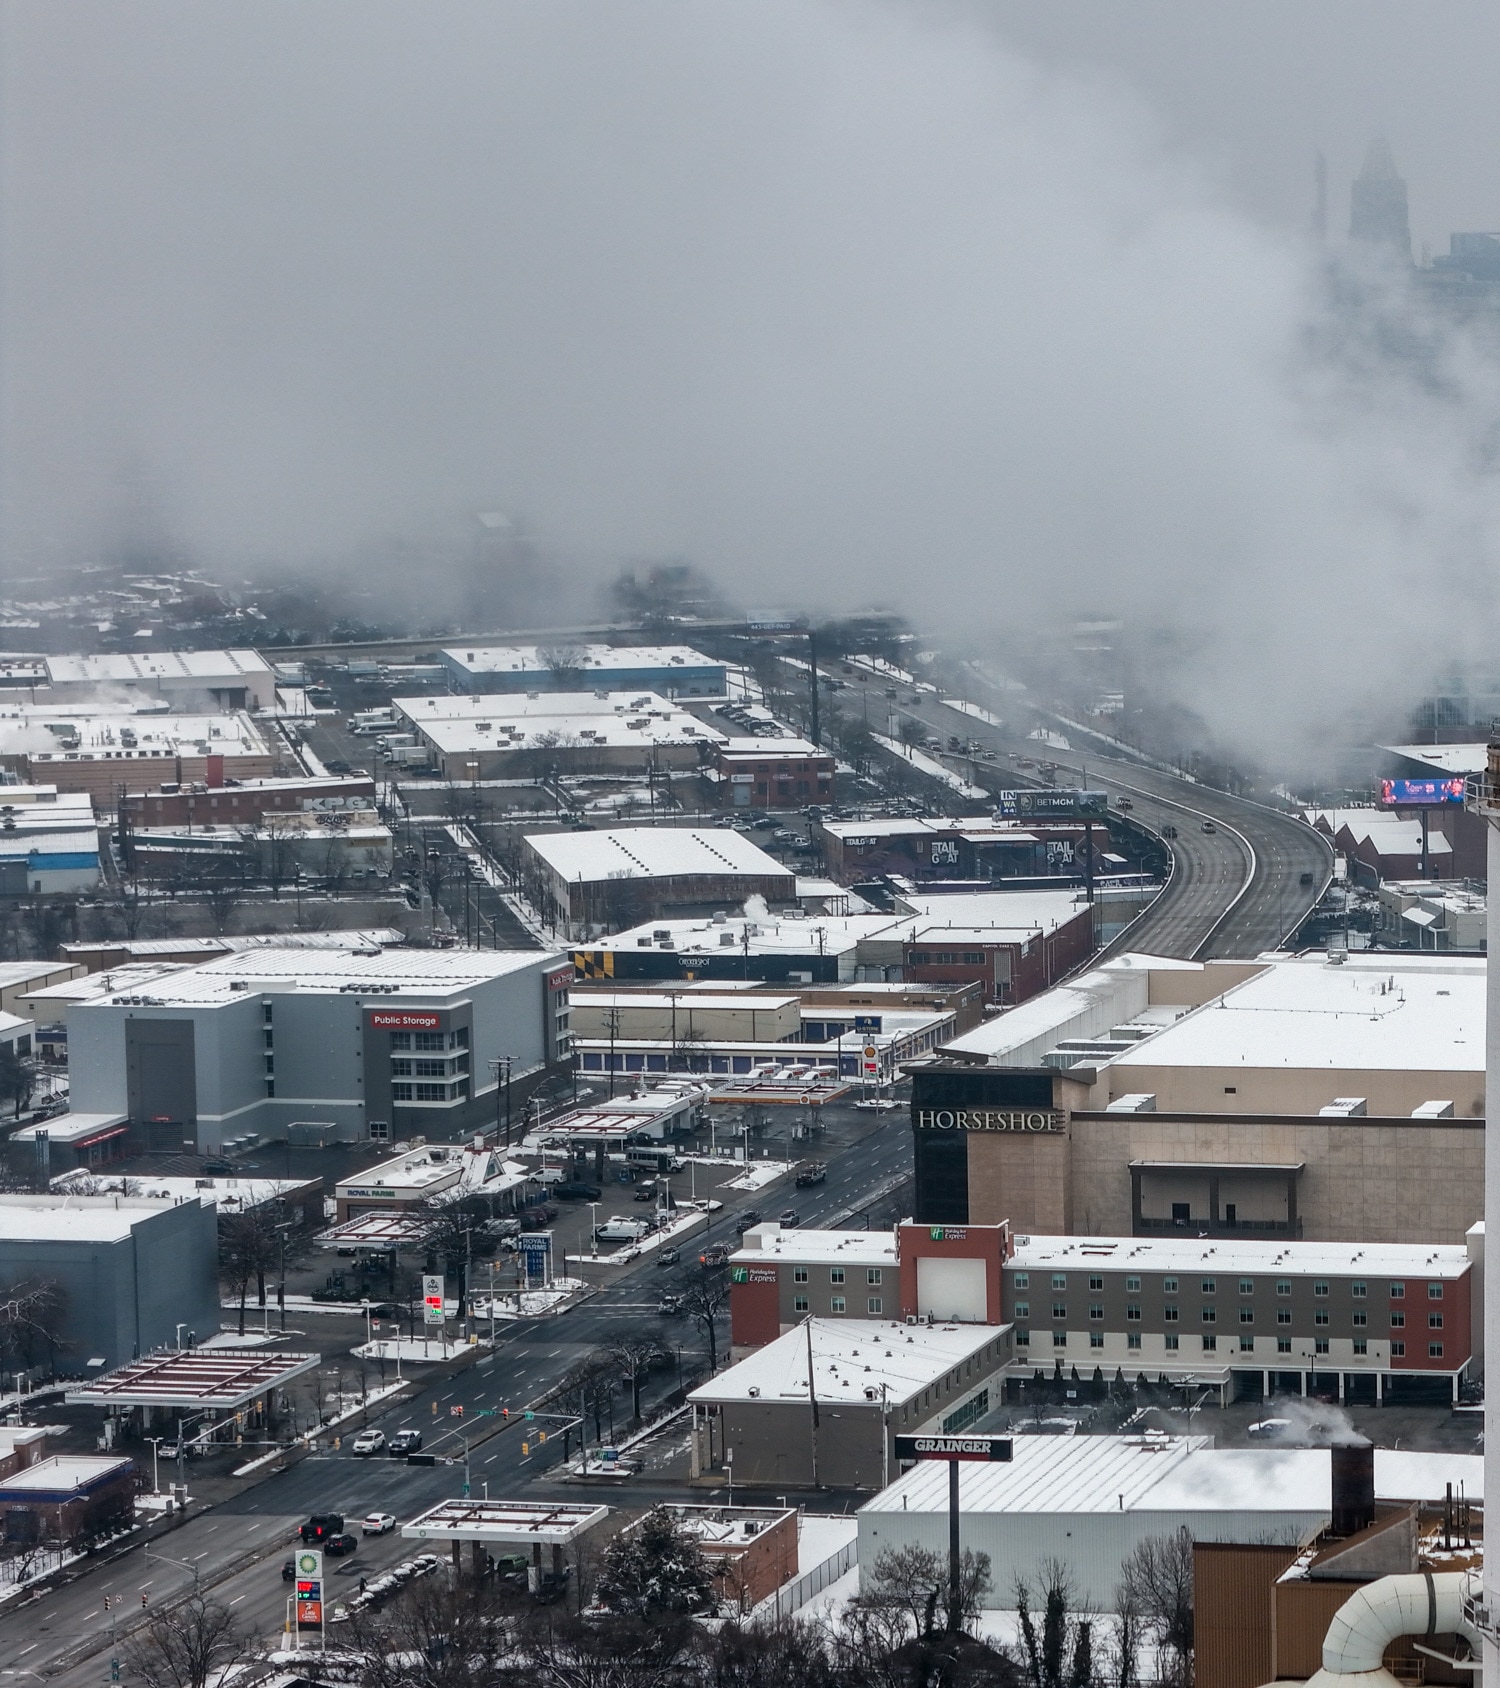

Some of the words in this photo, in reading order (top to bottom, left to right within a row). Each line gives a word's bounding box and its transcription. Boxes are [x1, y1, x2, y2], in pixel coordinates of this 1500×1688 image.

[374, 1016, 401, 1025] Public
[402, 1016, 436, 1027] Storage
[919, 1110, 1057, 1131] HORSESHOE
[347, 1189, 370, 1197] ROYAL
[371, 1190, 396, 1198] FARMS
[749, 1275, 777, 1283] Express
[915, 1439, 991, 1453] GRAINGER
